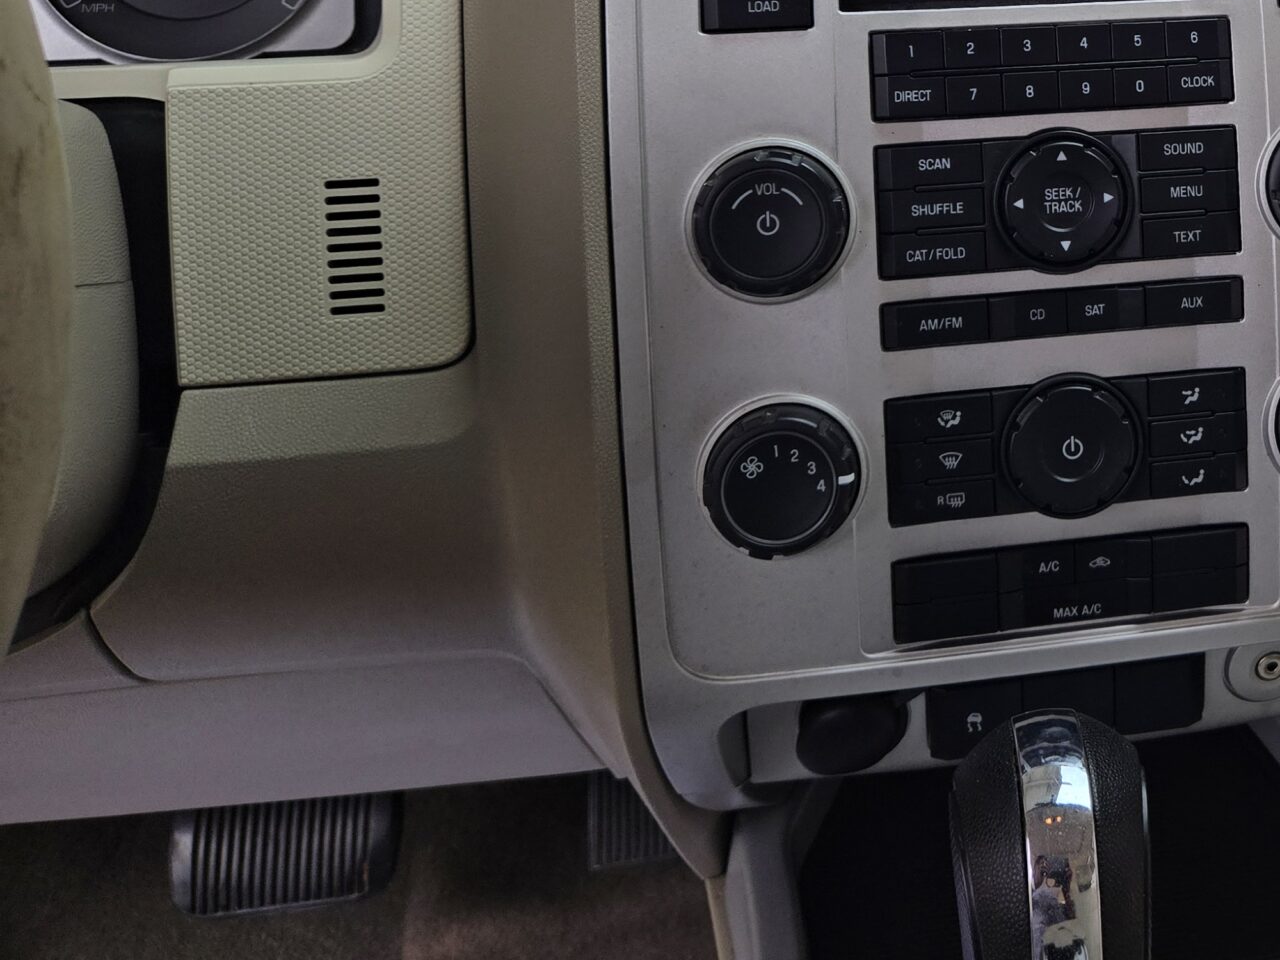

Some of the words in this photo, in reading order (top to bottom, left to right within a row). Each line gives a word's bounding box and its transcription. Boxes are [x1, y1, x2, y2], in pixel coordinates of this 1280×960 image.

[81, 3, 115, 13] MPH
[747, 0, 780, 13] LOAD
[1079, 37, 1088, 50] 4
[1133, 34, 1142, 47] 5
[1190, 31, 1199, 44] 6
[908, 44, 915, 58] 1
[966, 42, 975, 55] 2
[1022, 39, 1032, 52] 3
[1135, 79, 1144, 93] 0
[1180, 74, 1215, 89] CLOCK
[969, 88, 978, 101] 7
[1025, 85, 1034, 98] 8
[1081, 82, 1090, 95] 9
[894, 88, 932, 103] DIRECT
[1163, 141, 1204, 156] SOUND
[918, 157, 951, 171] SCAN
[755, 182, 780, 196] VOL
[1170, 184, 1204, 199] MENU
[911, 202, 964, 216] SHUFFLE
[1044, 200, 1083, 215] TRACK
[1173, 230, 1202, 243] TEXT
[1181, 296, 1204, 309] AUX
[1029, 308, 1045, 321] CD
[1085, 303, 1106, 317] SAT
[919, 316, 963, 331] AM/FM
[774, 444, 779, 458] 1
[790, 449, 799, 462] 2
[807, 461, 816, 475] 3
[816, 479, 826, 492] 4
[937, 495, 945, 506] R
[1038, 560, 1060, 573] A/C
[1053, 606, 1078, 619] MAX
[1081, 603, 1102, 616] A/C
